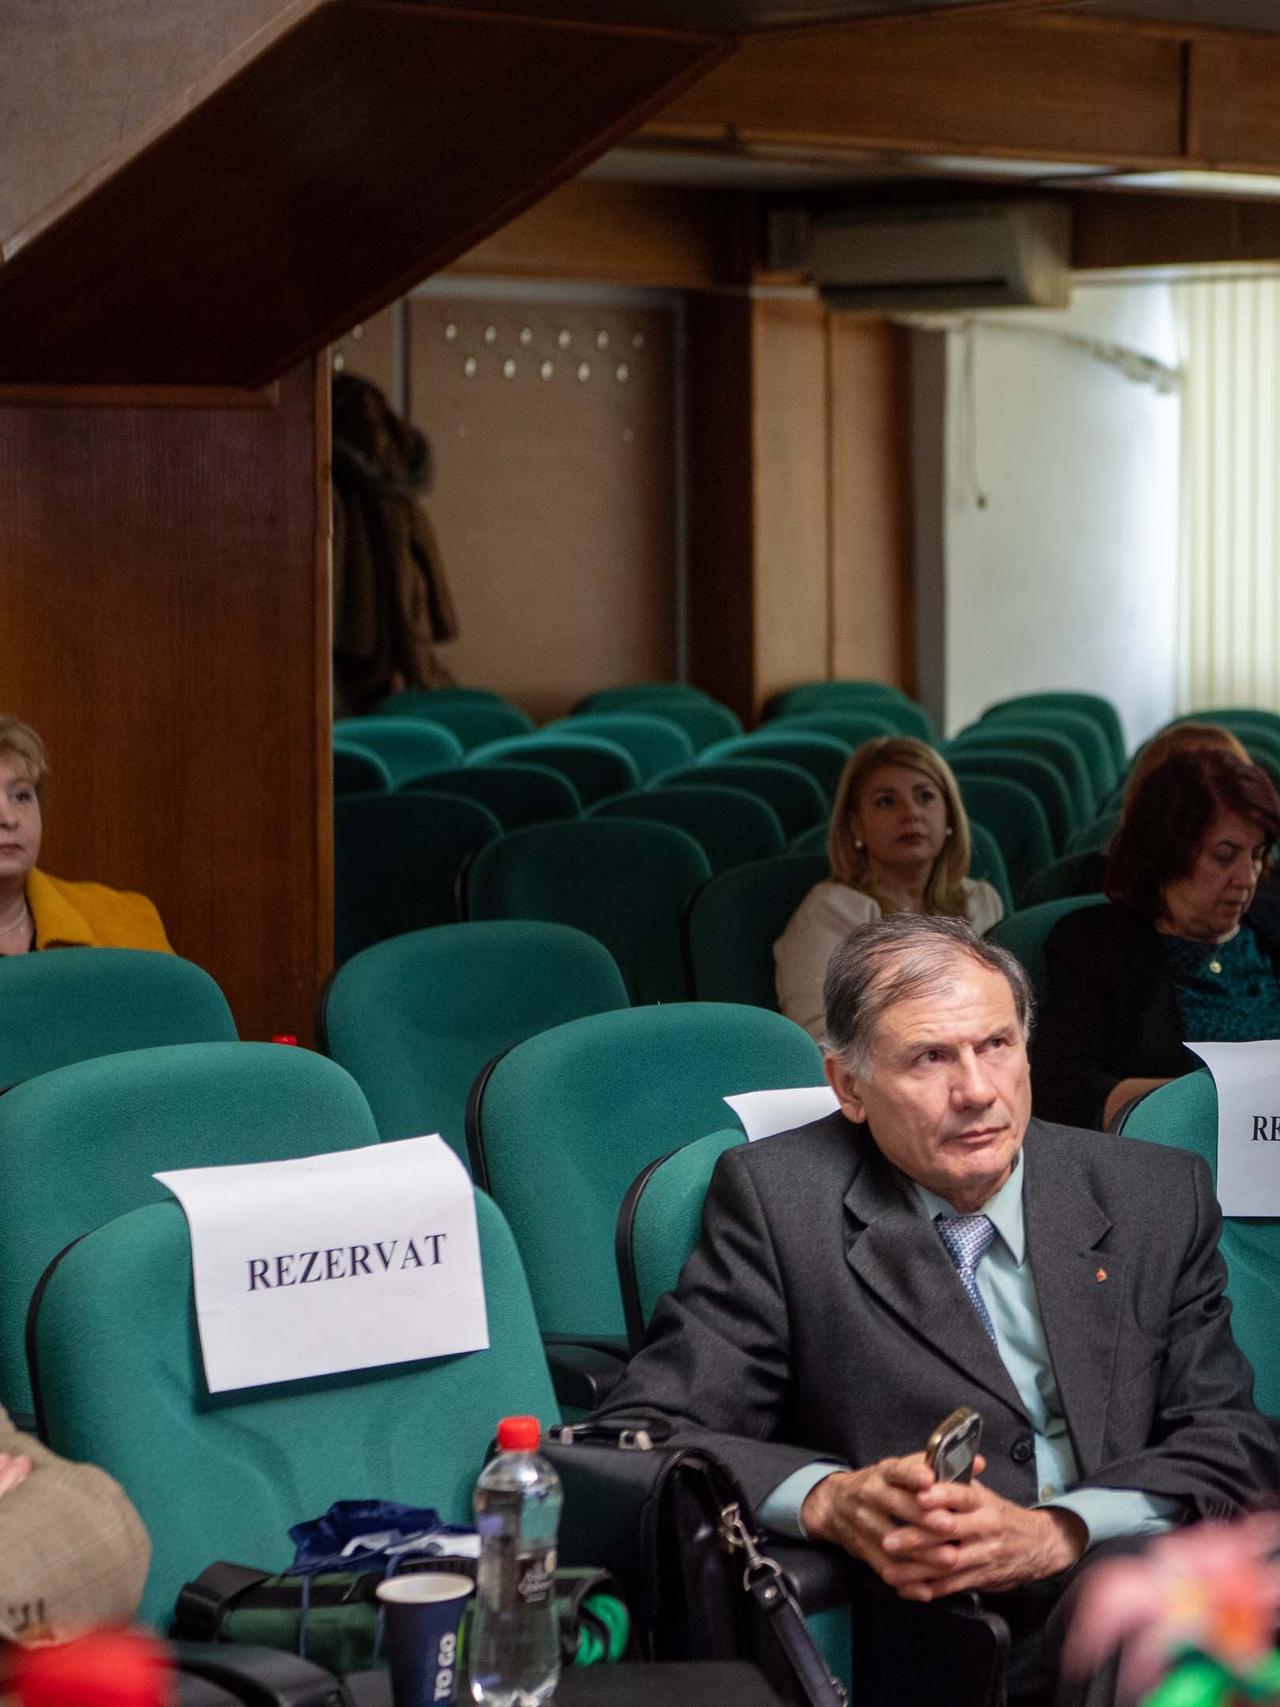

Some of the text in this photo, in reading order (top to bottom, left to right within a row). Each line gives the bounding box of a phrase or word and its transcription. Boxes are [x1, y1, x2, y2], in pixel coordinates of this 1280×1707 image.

[247, 1233, 446, 1292] REZERVAT
[435, 1633, 457, 1700] TO GO
